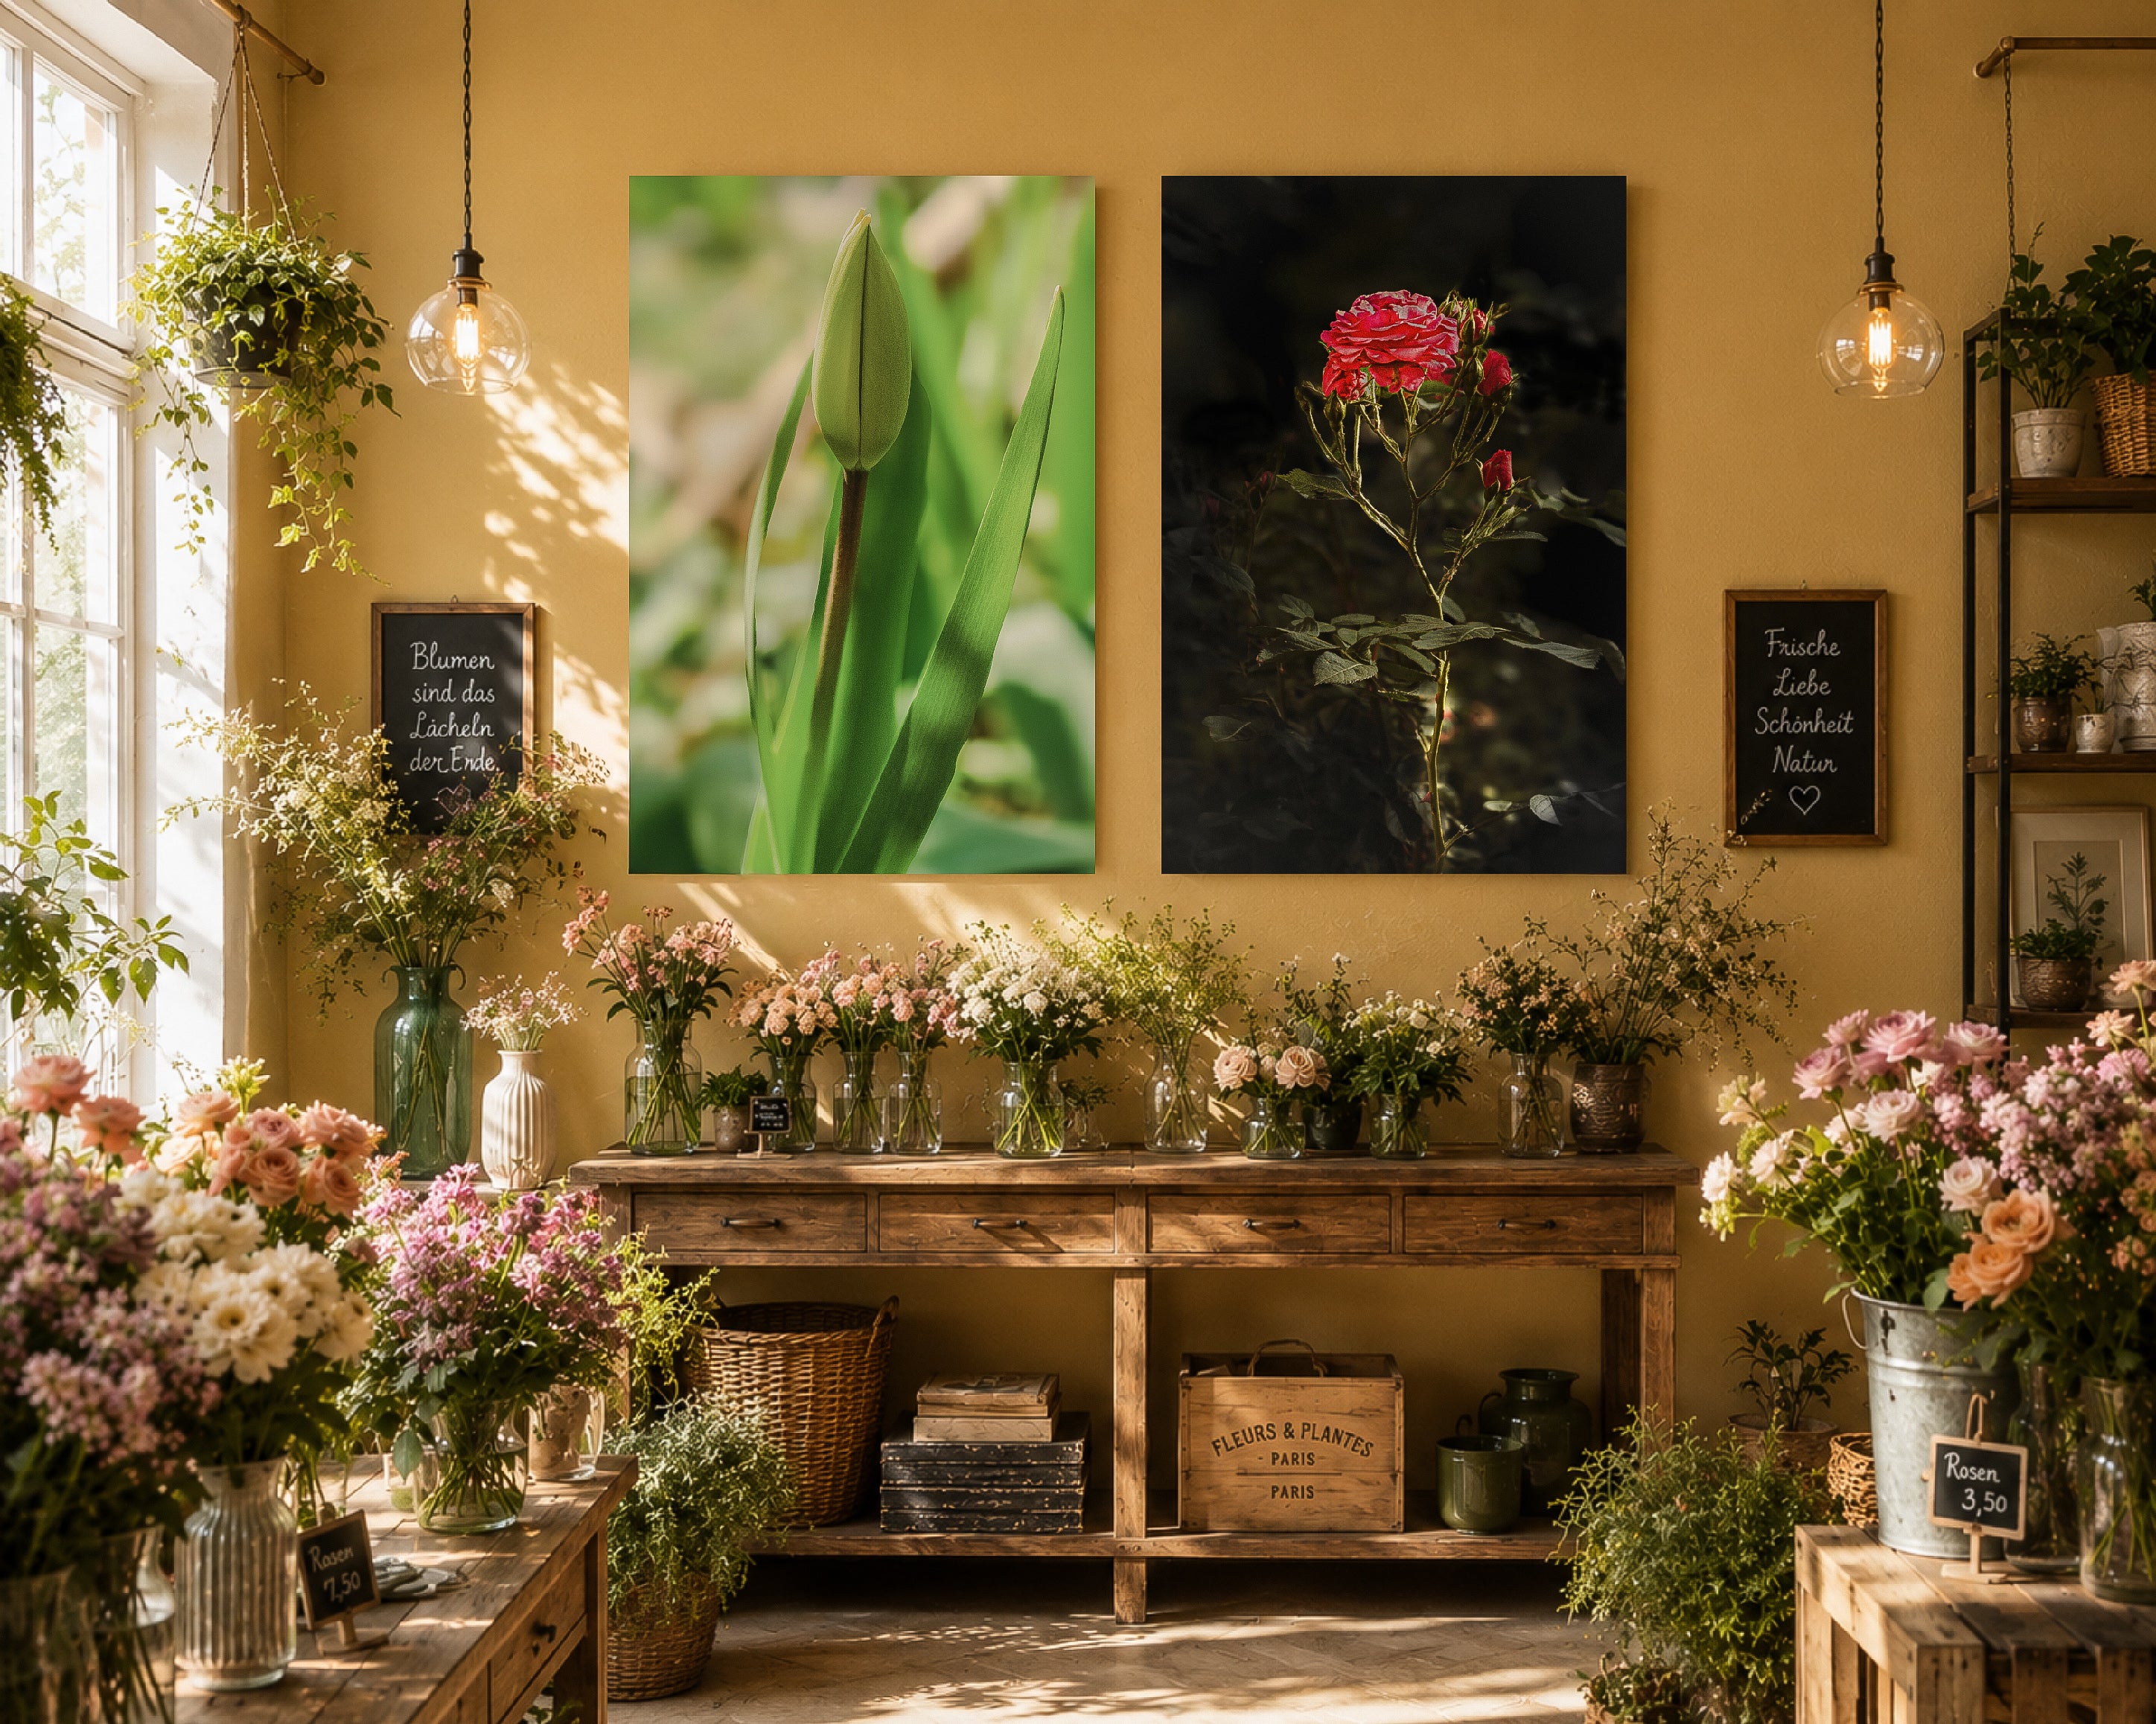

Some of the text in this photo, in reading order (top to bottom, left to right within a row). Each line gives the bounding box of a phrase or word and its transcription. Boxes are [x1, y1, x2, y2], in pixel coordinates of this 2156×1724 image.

[409, 641, 495, 670] Blumen
[1764, 627, 1841, 657] Frische
[412, 678, 495, 703] sind das
[1773, 667, 1831, 696] Liebe
[1754, 706, 1854, 735] Schönheit
[409, 747, 449, 773] der
[1772, 744, 1838, 773] Natur
[1211, 1422, 1374, 1458] FLEURS & PLANTES
[1271, 1452, 1315, 1466] PARIS
[1943, 1452, 2001, 1483] Rosen
[1271, 1485, 1315, 1499] PARIS
[1962, 1488, 2008, 1517] 3,50
[308, 1545, 354, 1573] Rosen
